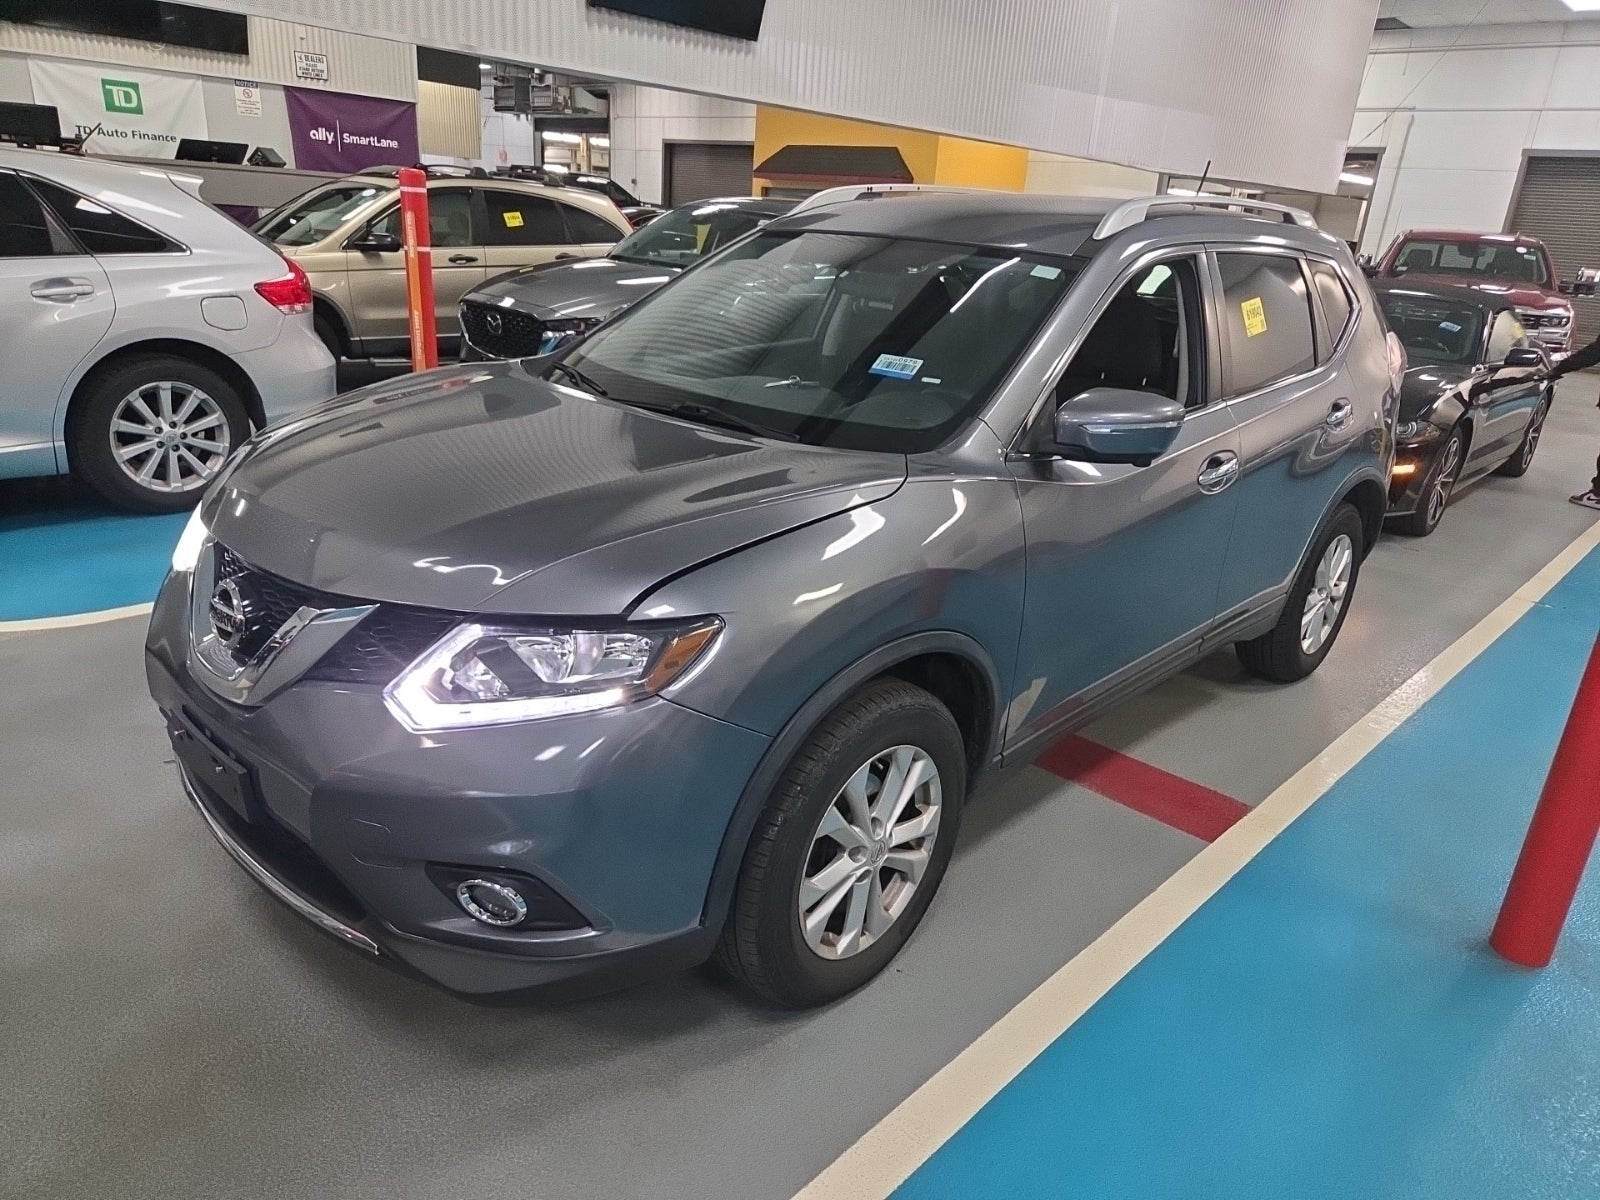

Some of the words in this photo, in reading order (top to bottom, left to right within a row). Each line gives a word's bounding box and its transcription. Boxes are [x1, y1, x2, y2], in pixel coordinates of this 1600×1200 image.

[304, 54, 324, 64] DEALERS
[235, 80, 257, 88] NOTICE
[105, 84, 138, 108] TD
[75, 124, 92, 137] TD
[97, 126, 128, 139] Auto
[131, 130, 177, 143] Finance
[309, 127, 335, 145] ally
[343, 132, 399, 149] SmartLane
